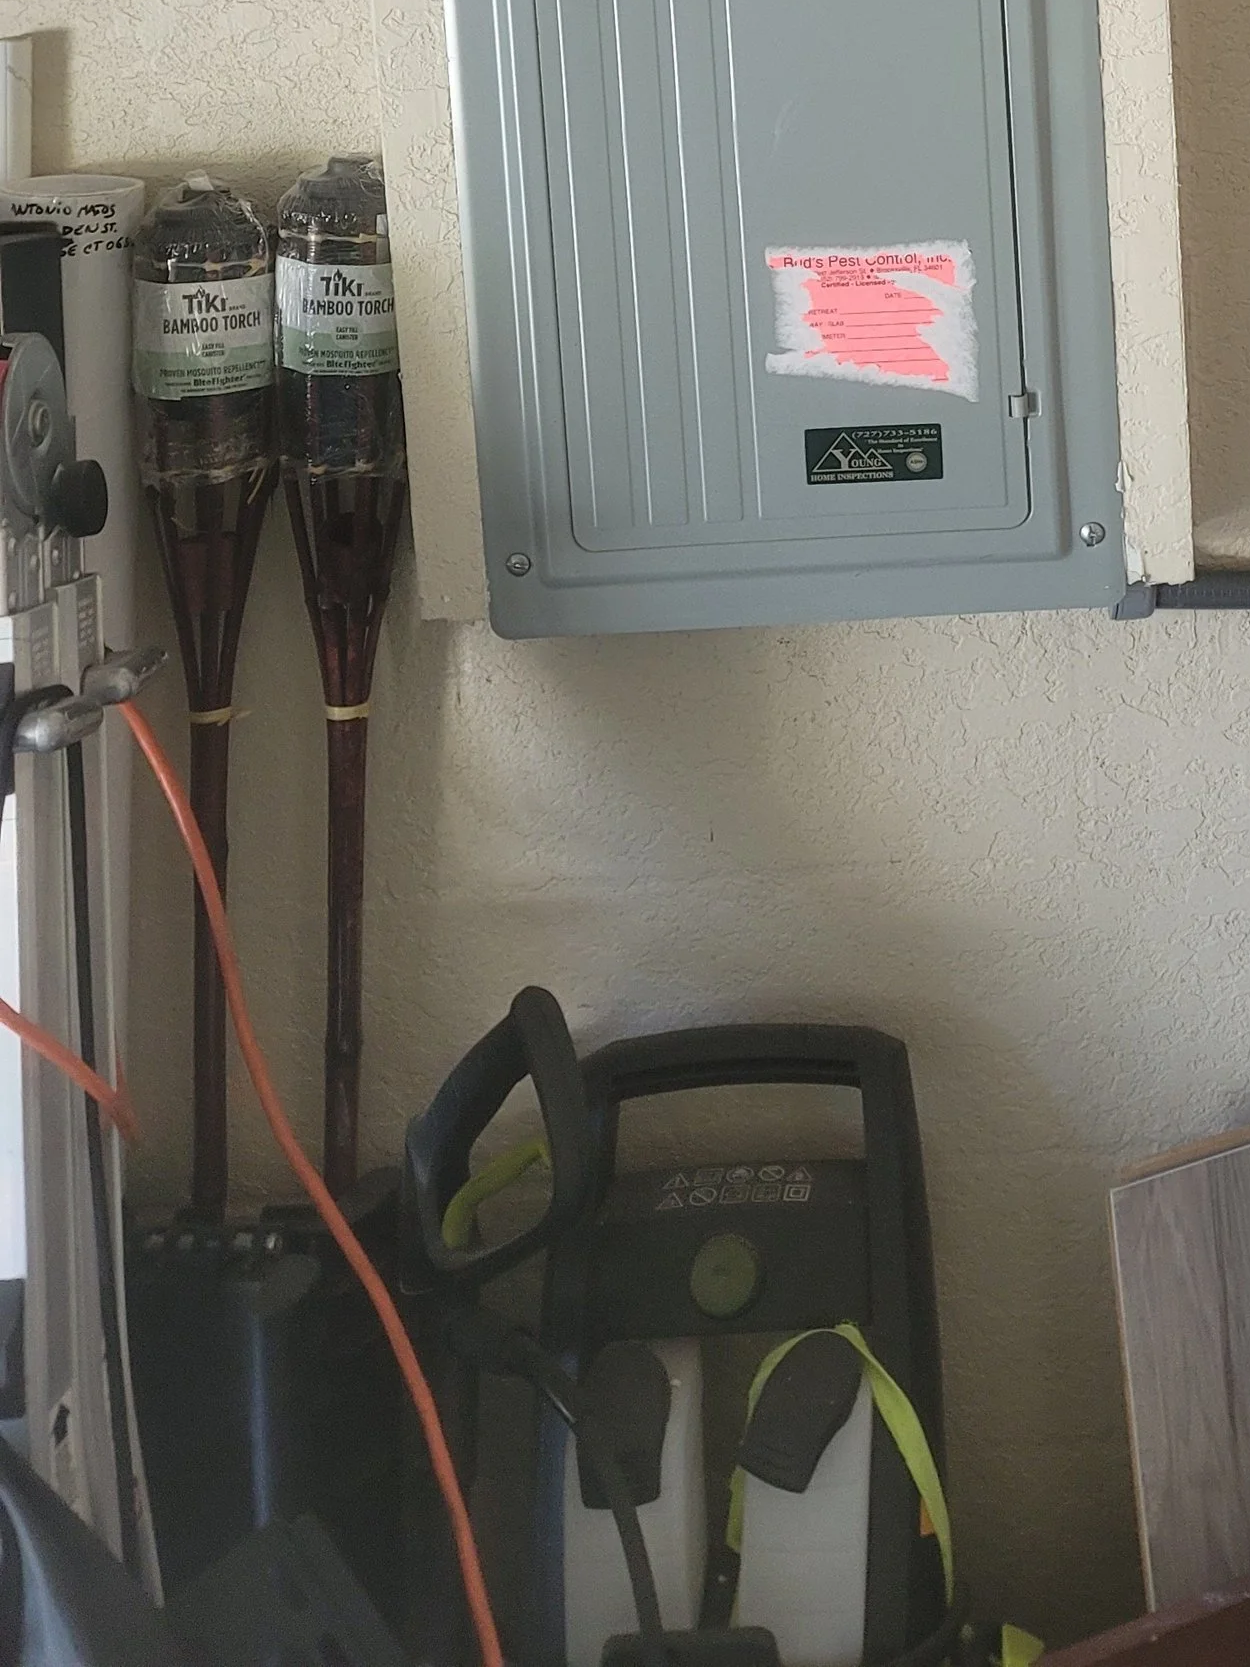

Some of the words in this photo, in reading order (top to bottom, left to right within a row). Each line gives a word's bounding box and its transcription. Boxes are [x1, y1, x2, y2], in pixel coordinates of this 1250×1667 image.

[828, 255, 861, 268] Pest
[303, 298, 354, 316] BAMBOO
[358, 297, 394, 316] TORCH
[163, 317, 219, 335] BAMBOO
[222, 310, 261, 332] TORCH
[320, 350, 354, 359] MOSQUITO
[187, 366, 222, 377] MOSQUITO
[811, 473, 836, 482] HOME
[837, 471, 894, 481] INSPECTIONS
